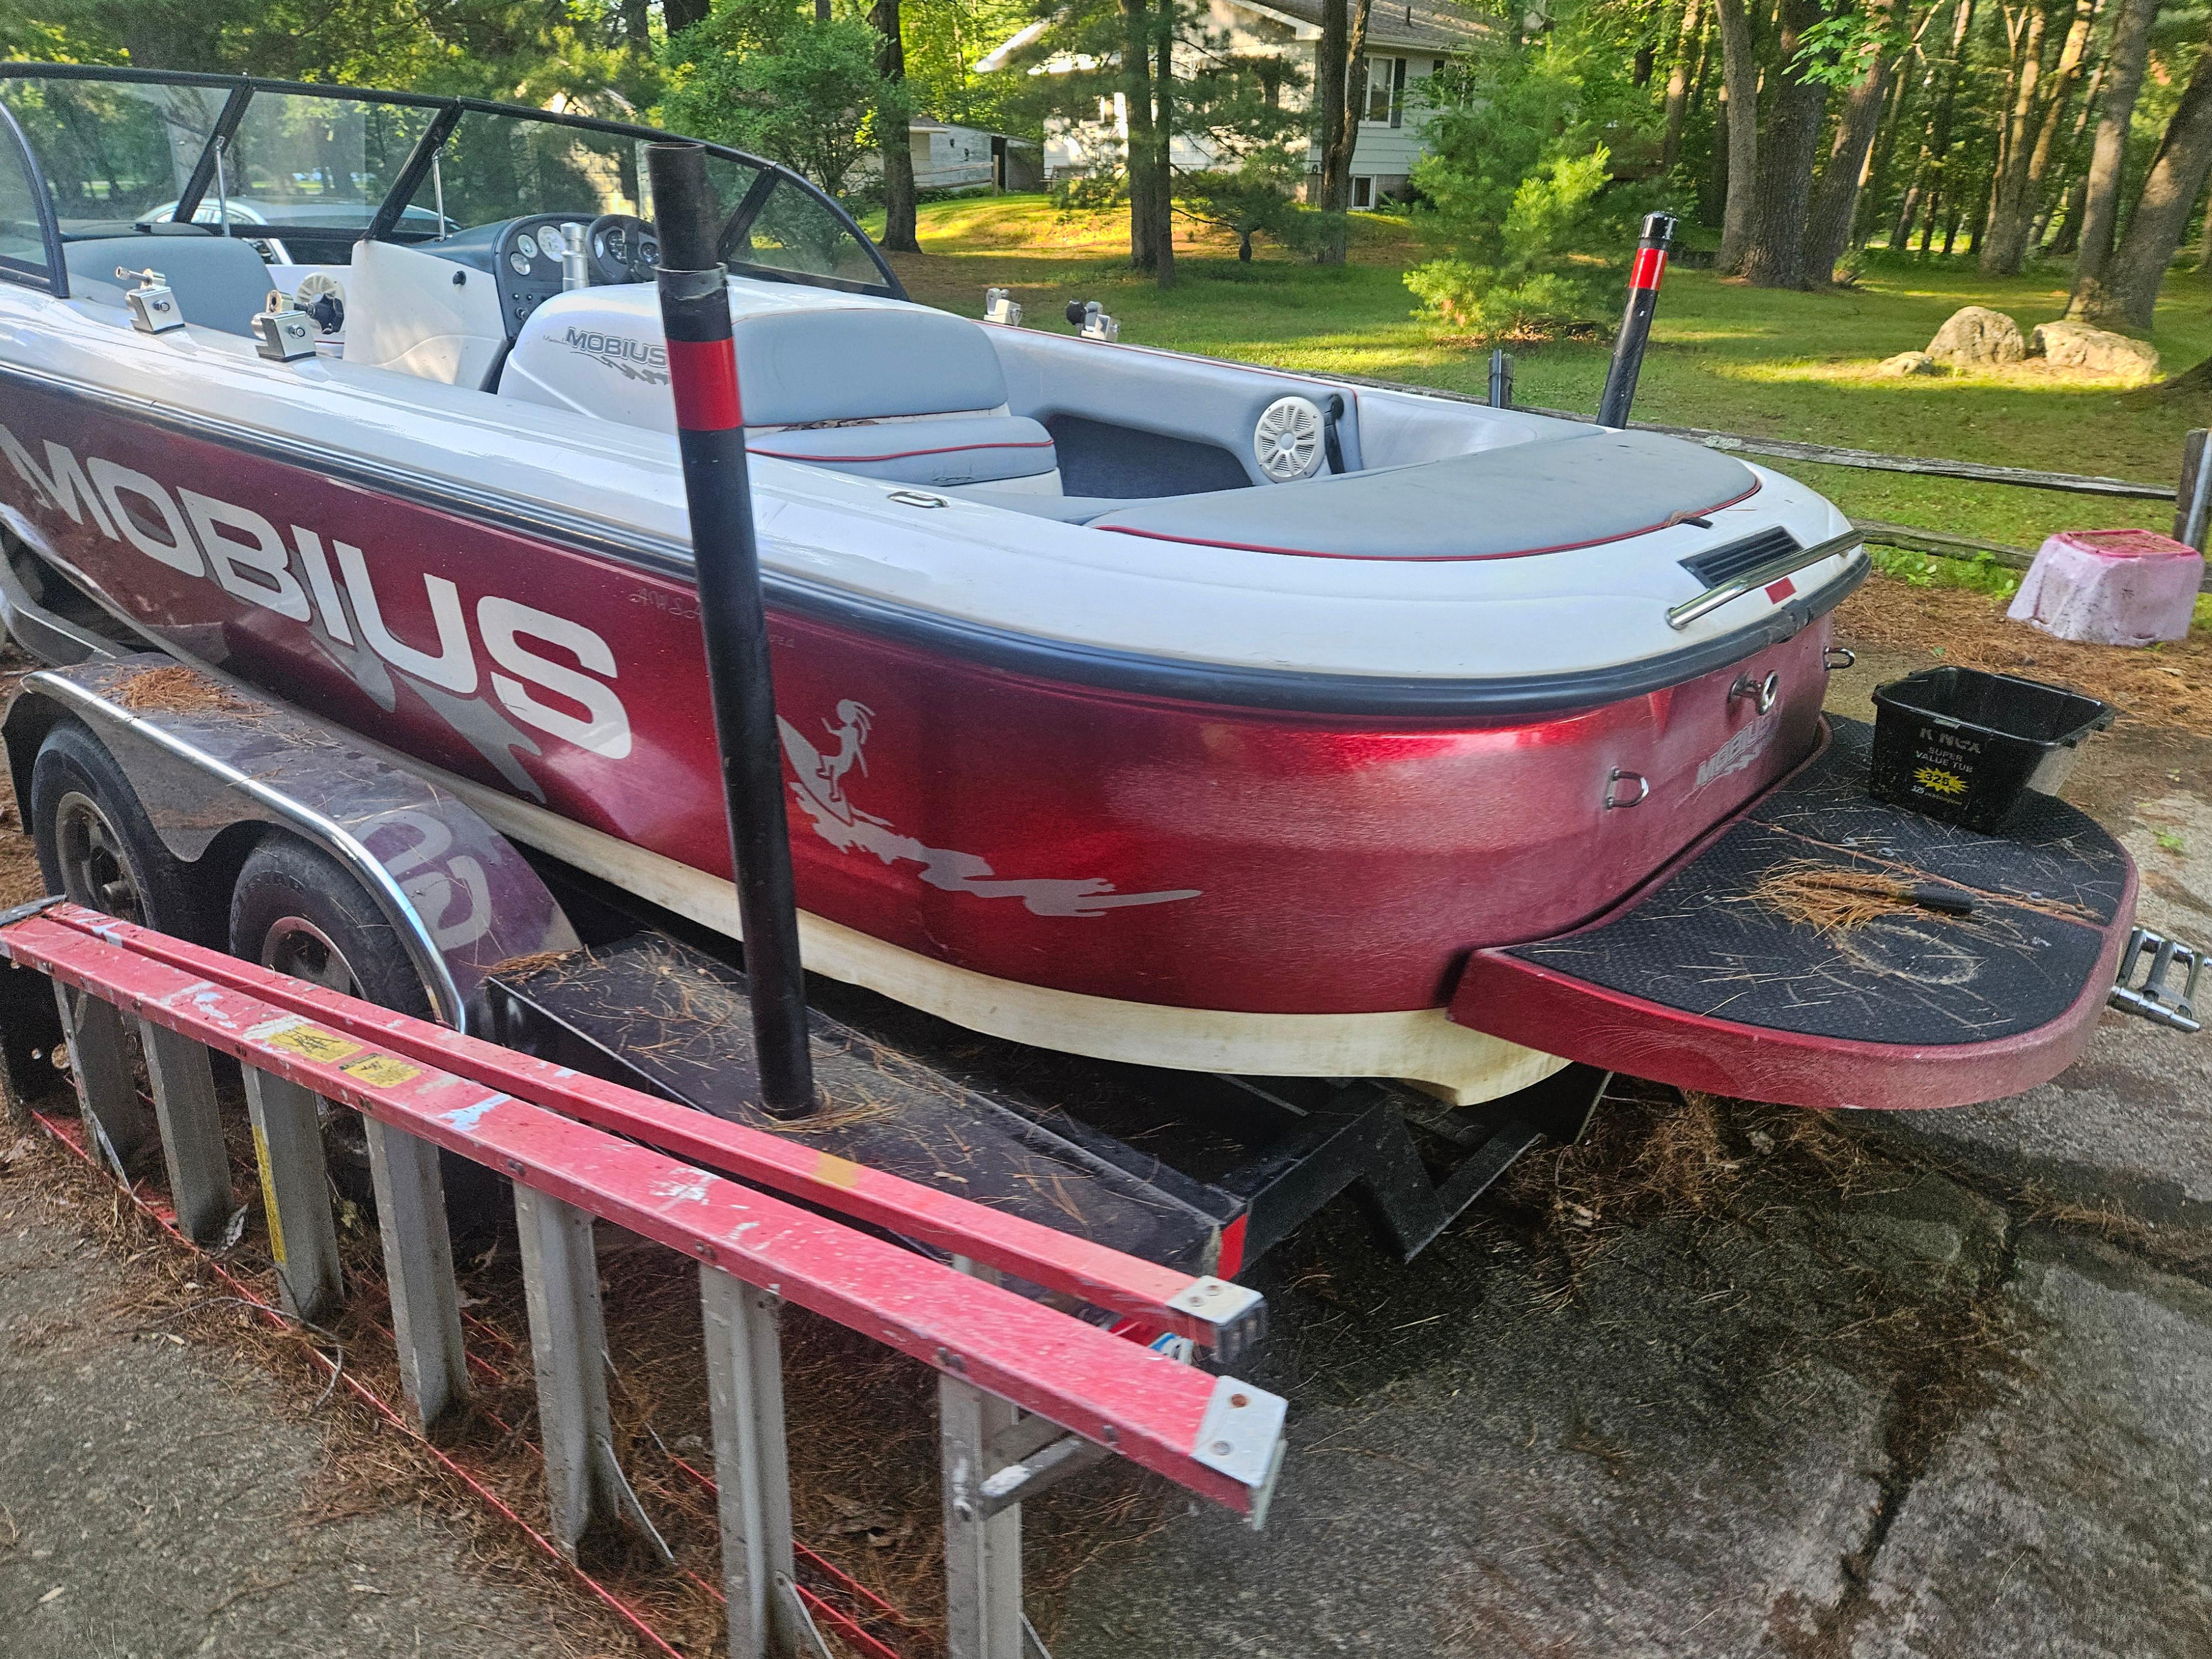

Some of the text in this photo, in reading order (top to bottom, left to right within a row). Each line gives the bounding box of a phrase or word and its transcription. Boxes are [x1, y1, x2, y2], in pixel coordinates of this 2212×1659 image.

[566, 326, 669, 368] MOBIUS
[0, 422, 632, 759] MOBIUS
[1694, 714, 1773, 787] MOBIUS
[1916, 750, 1973, 773] VALUE TUB
[1929, 747, 1963, 762] SUPER
[1924, 772, 1949, 786] 325
